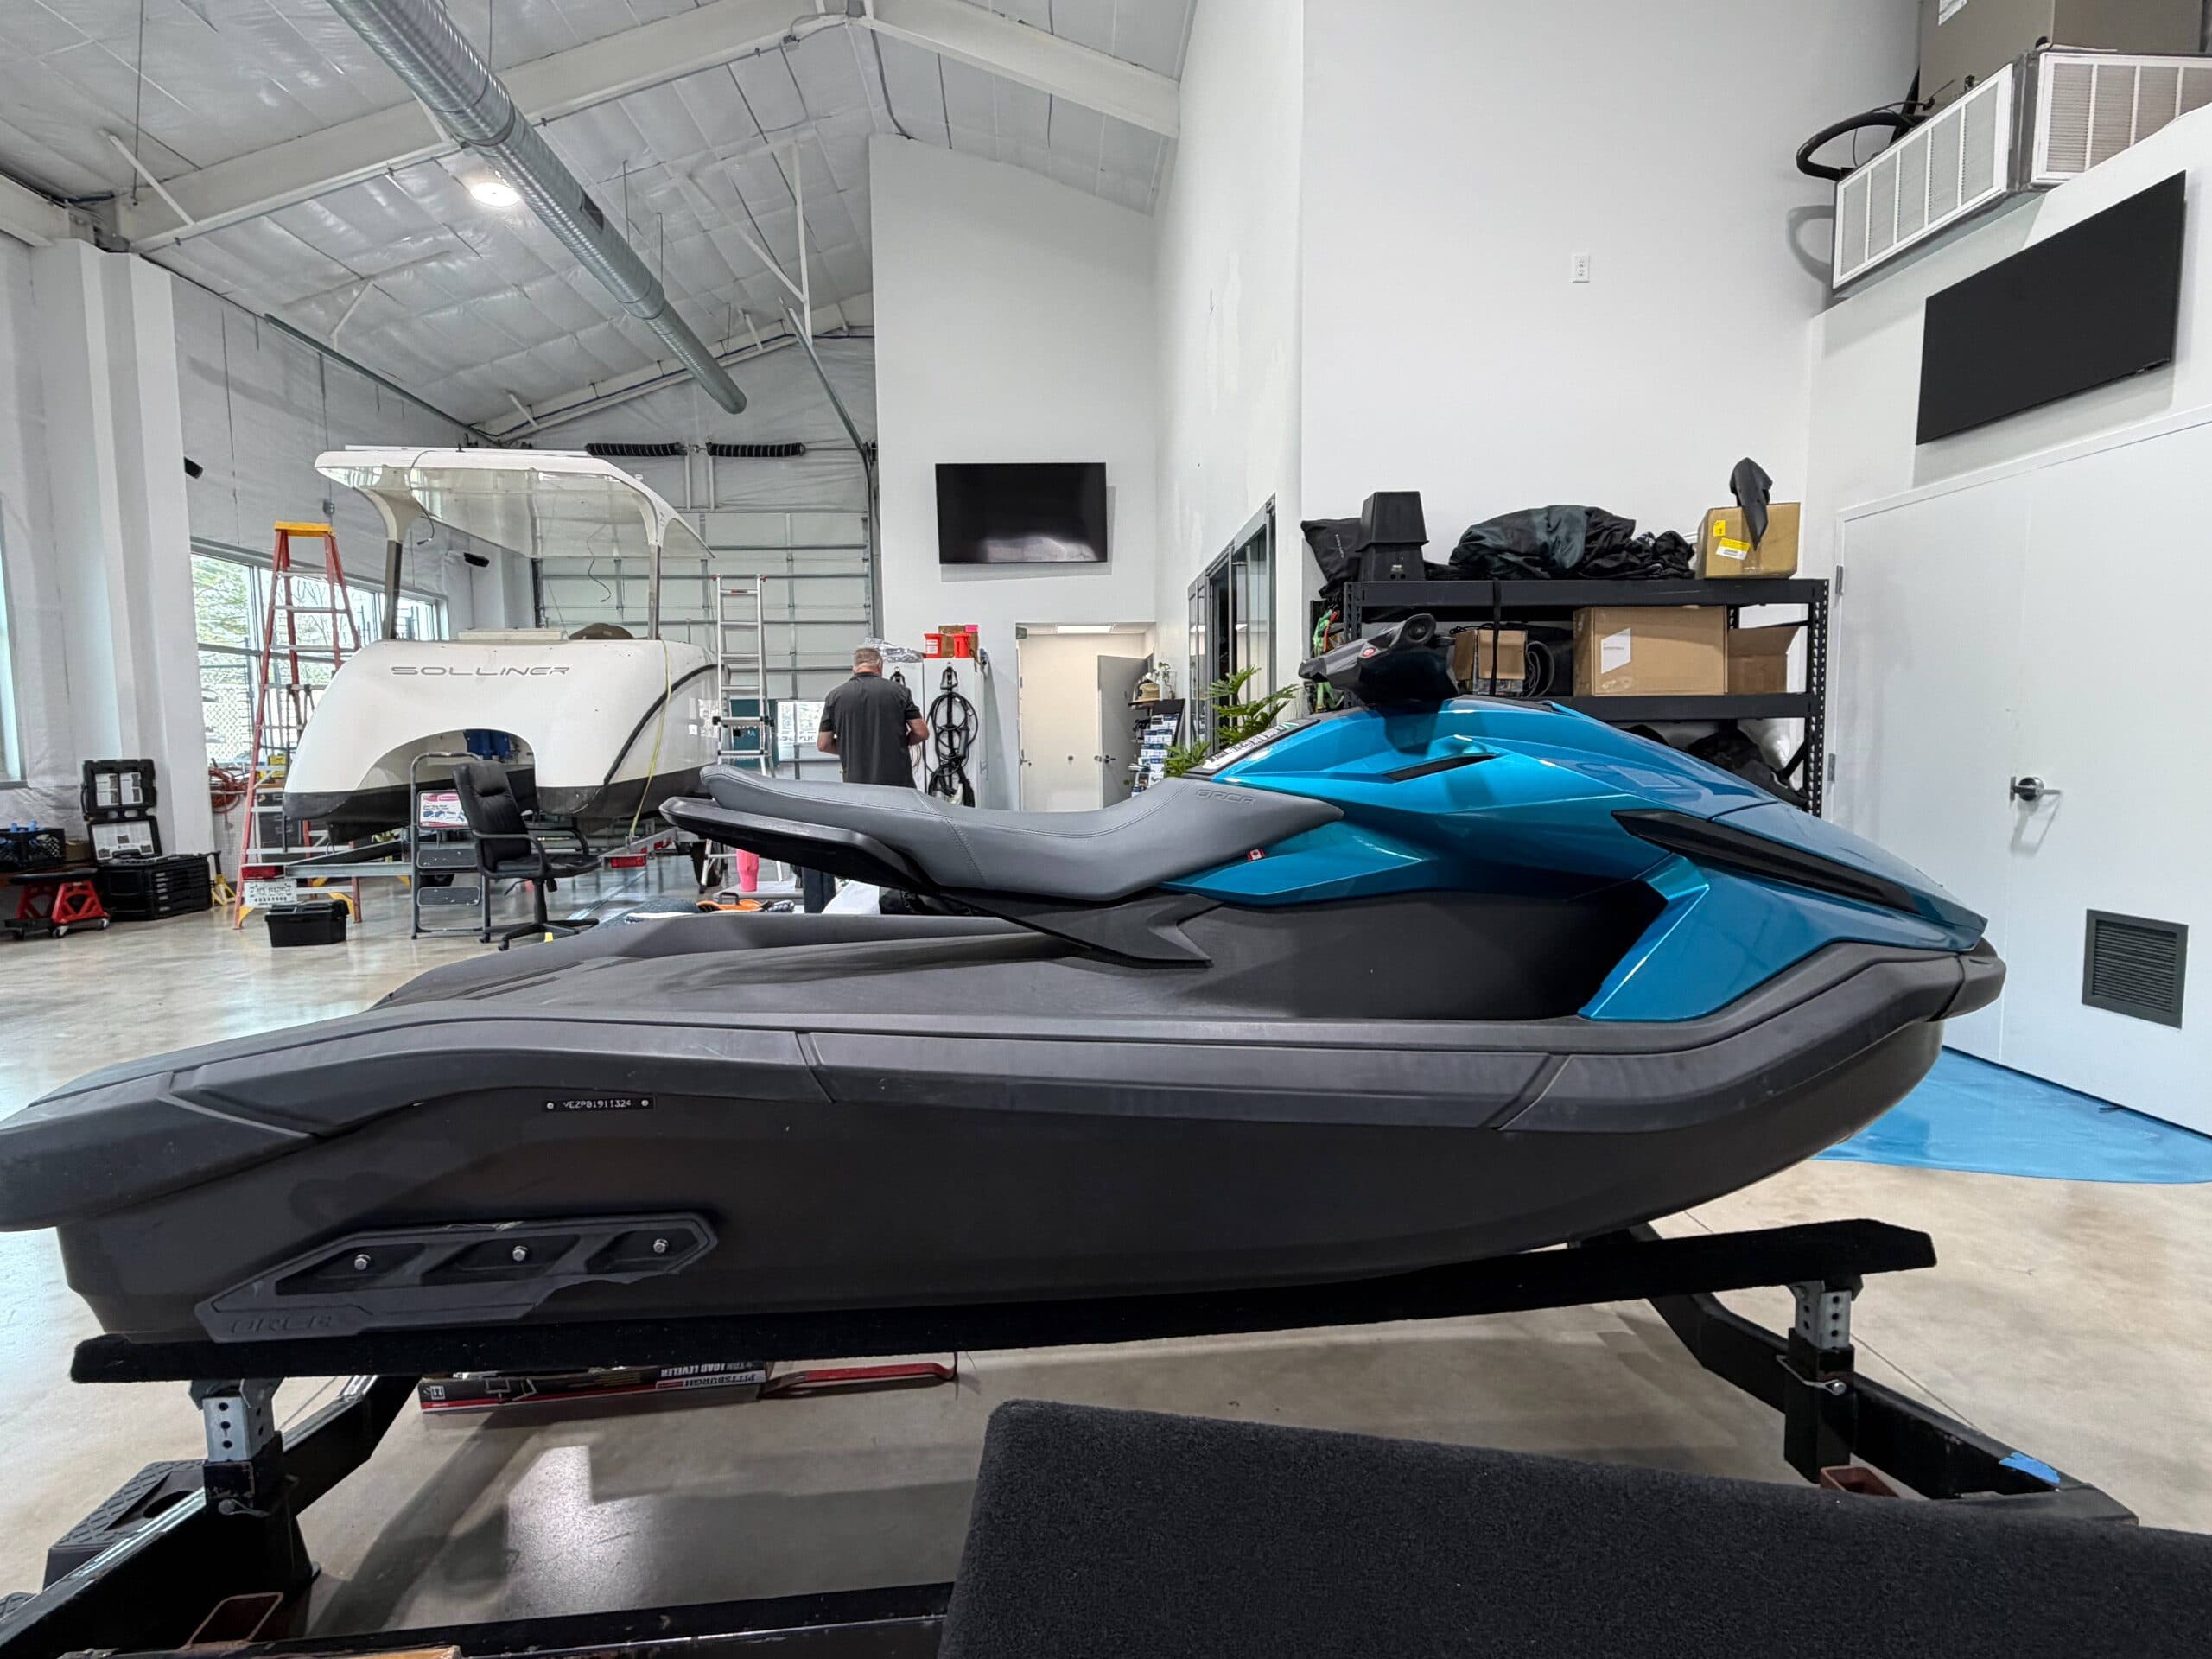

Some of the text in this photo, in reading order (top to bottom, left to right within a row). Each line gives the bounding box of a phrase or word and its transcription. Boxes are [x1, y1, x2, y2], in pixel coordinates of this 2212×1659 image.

[391, 666, 570, 676] SOLLINER
[1196, 788, 1256, 805] ORCA
[661, 1365, 699, 1377] LEVELER
[700, 1363, 726, 1373] LOAD
[684, 1374, 754, 1387] PITTSBURGH
